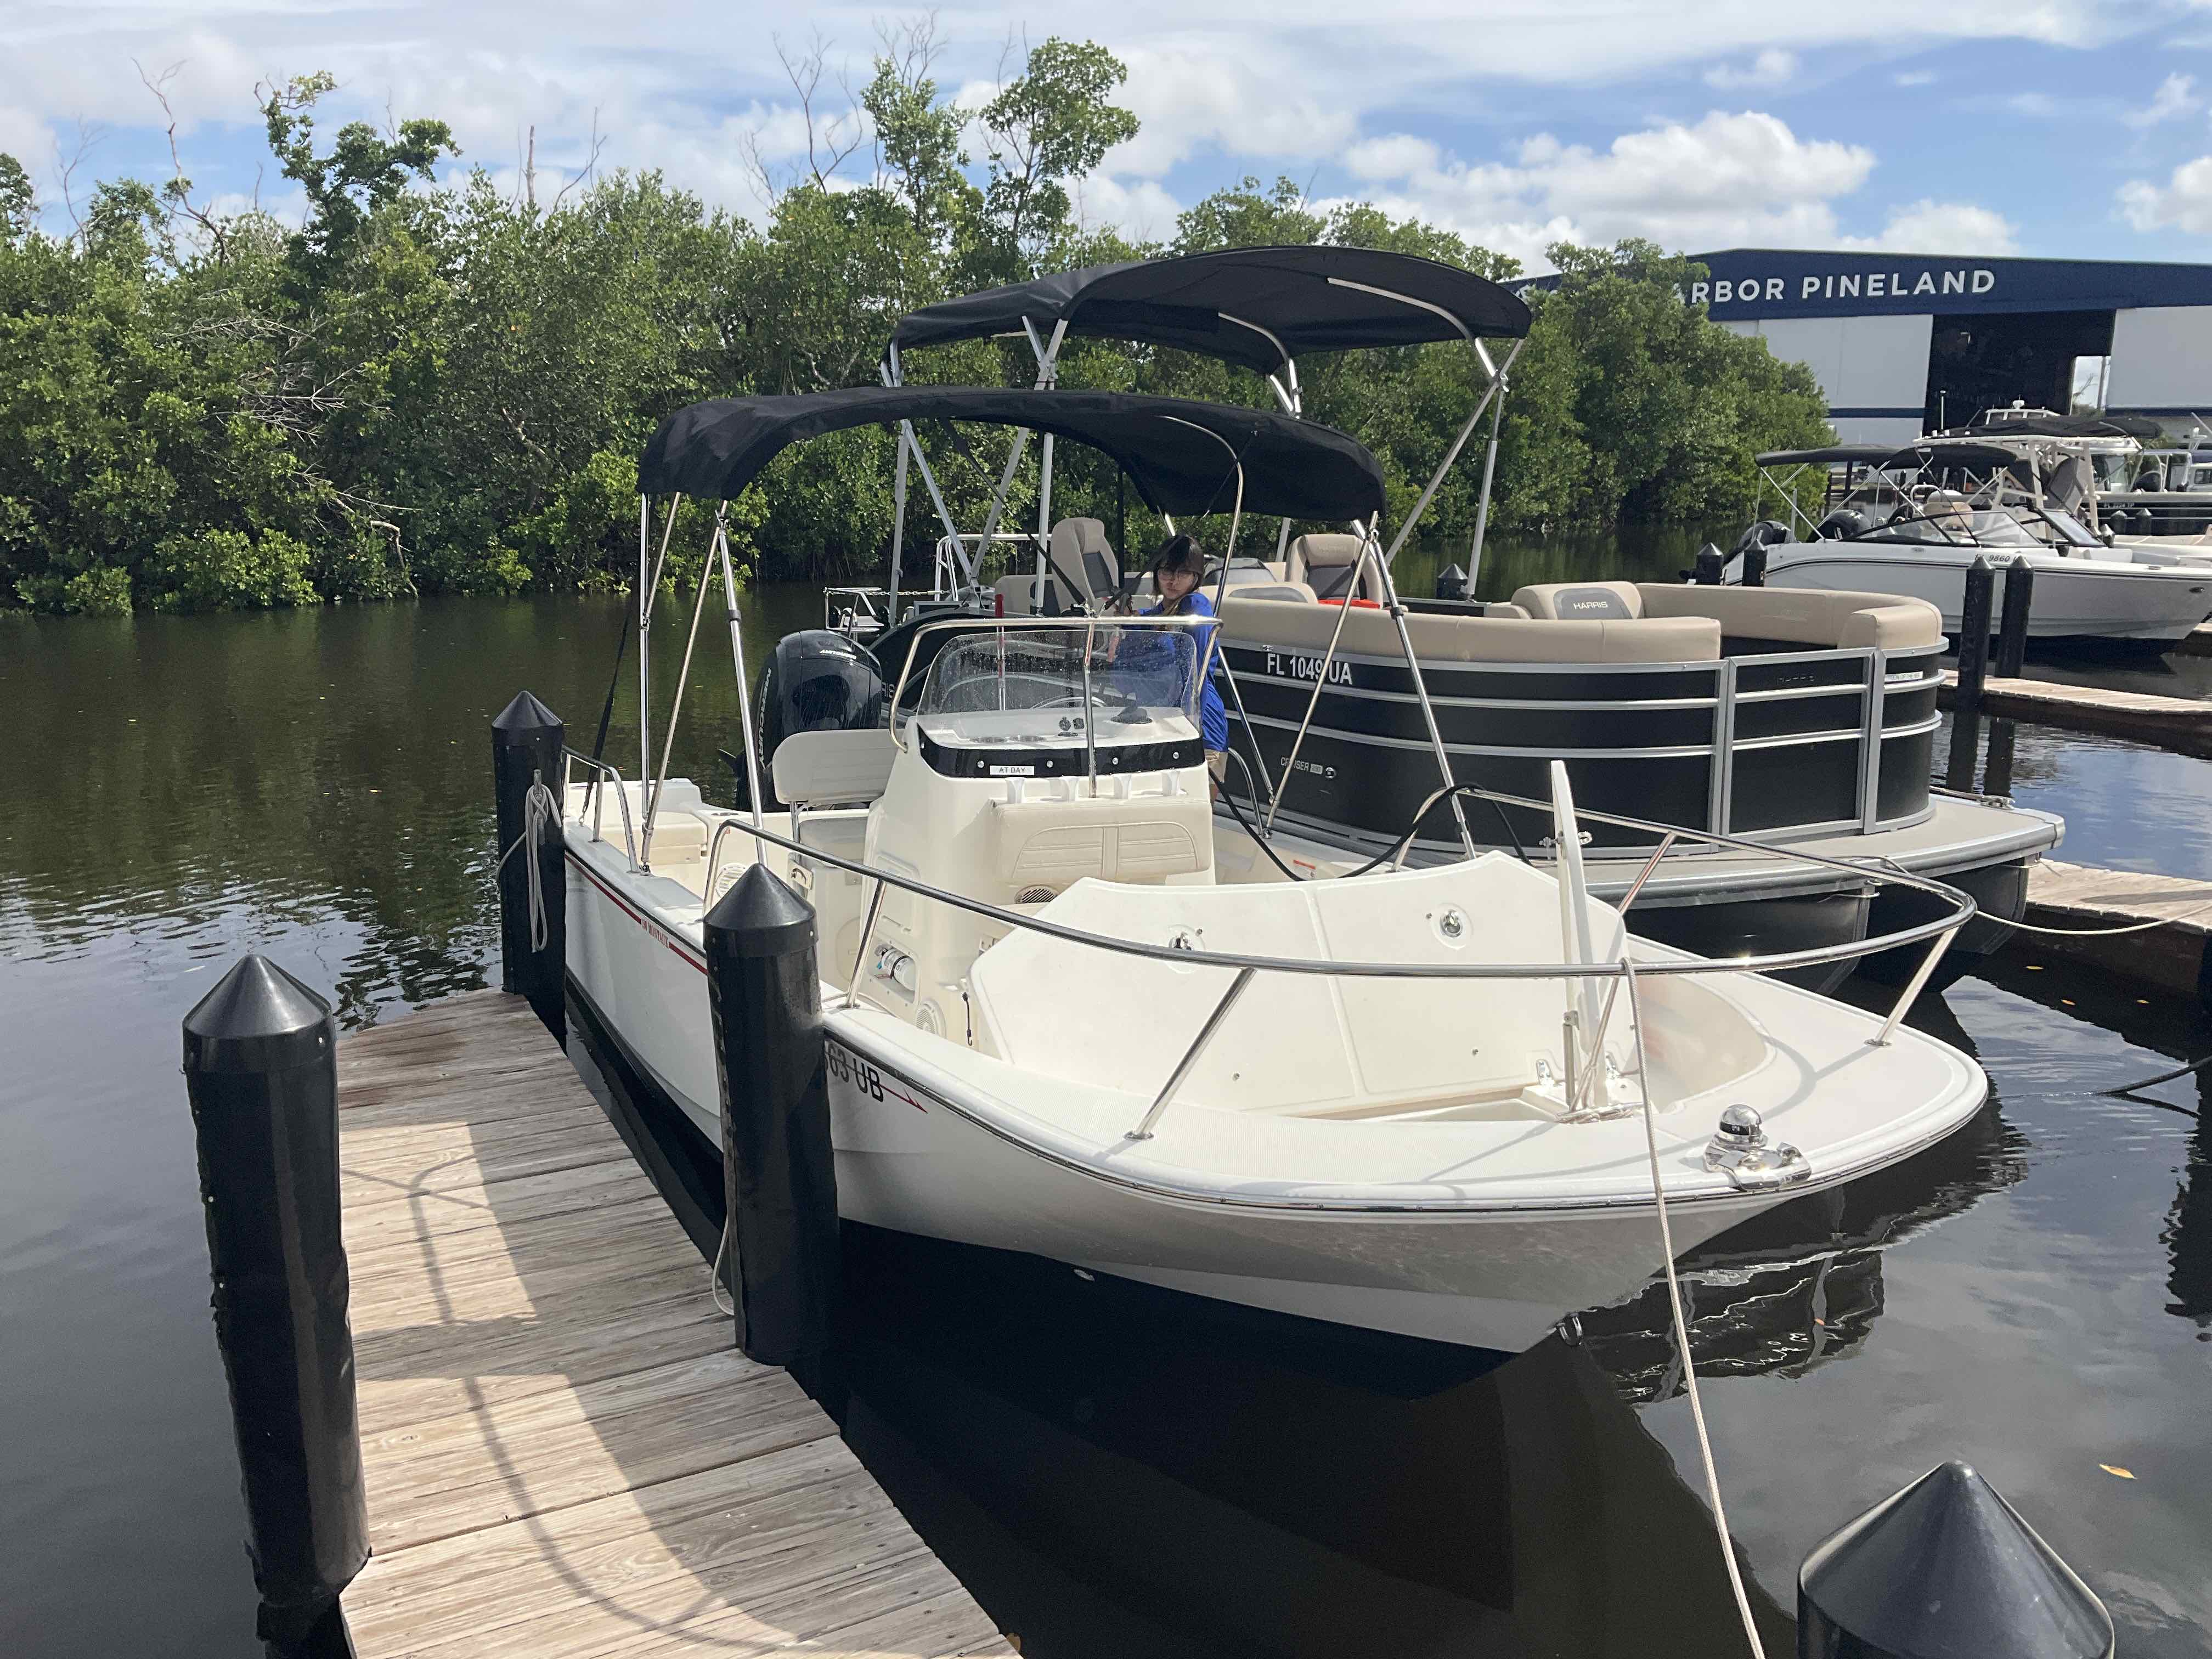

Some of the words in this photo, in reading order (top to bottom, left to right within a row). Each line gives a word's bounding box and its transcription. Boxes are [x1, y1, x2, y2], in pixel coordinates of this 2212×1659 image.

[1802, 270, 1995, 298] PINELAND
[1573, 601, 1608, 610] HARRIS
[1267, 653, 1285, 675] FL
[1290, 656, 1323, 680] 1049
[1329, 661, 1352, 685] UA
[759, 667, 772, 769] MERCURY
[825, 1043, 849, 1082] 63
[853, 1057, 884, 1102] UB
